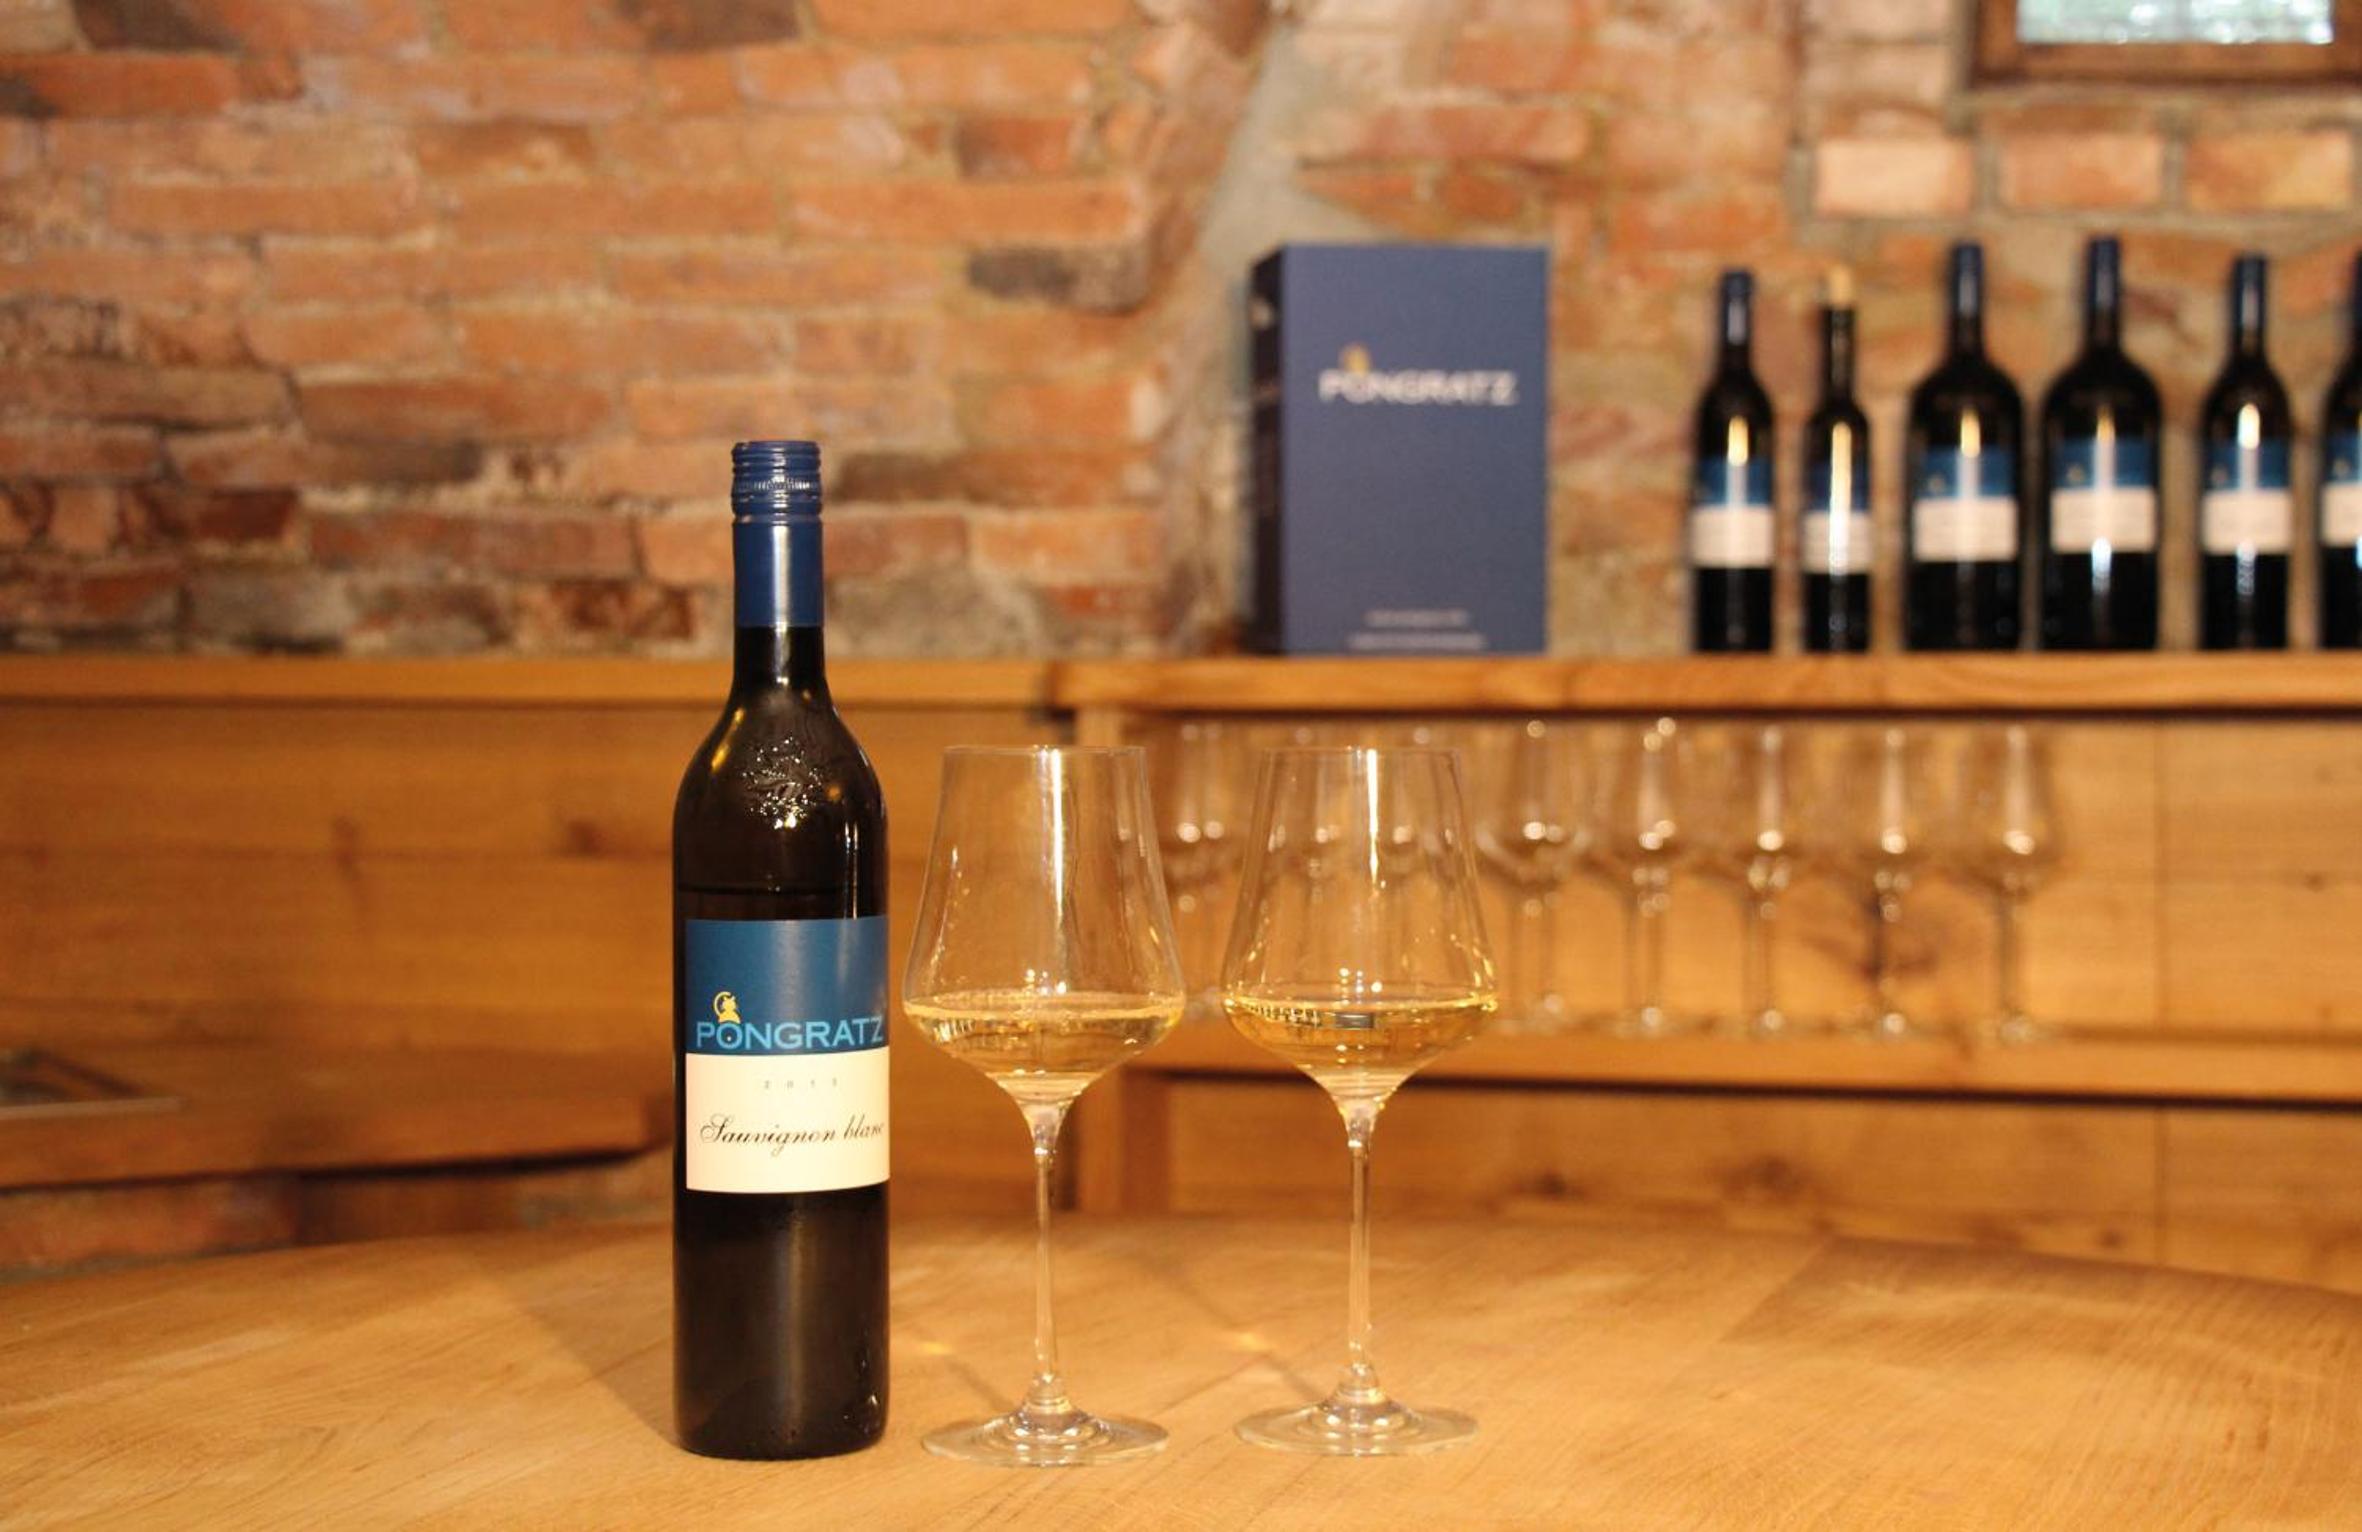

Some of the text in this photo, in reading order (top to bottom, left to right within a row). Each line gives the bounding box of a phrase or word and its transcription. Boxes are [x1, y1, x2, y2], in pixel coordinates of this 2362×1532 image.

[696, 1016, 883, 1050] PONGRATZ
[700, 1113, 885, 1157] Sauvignon blanc
